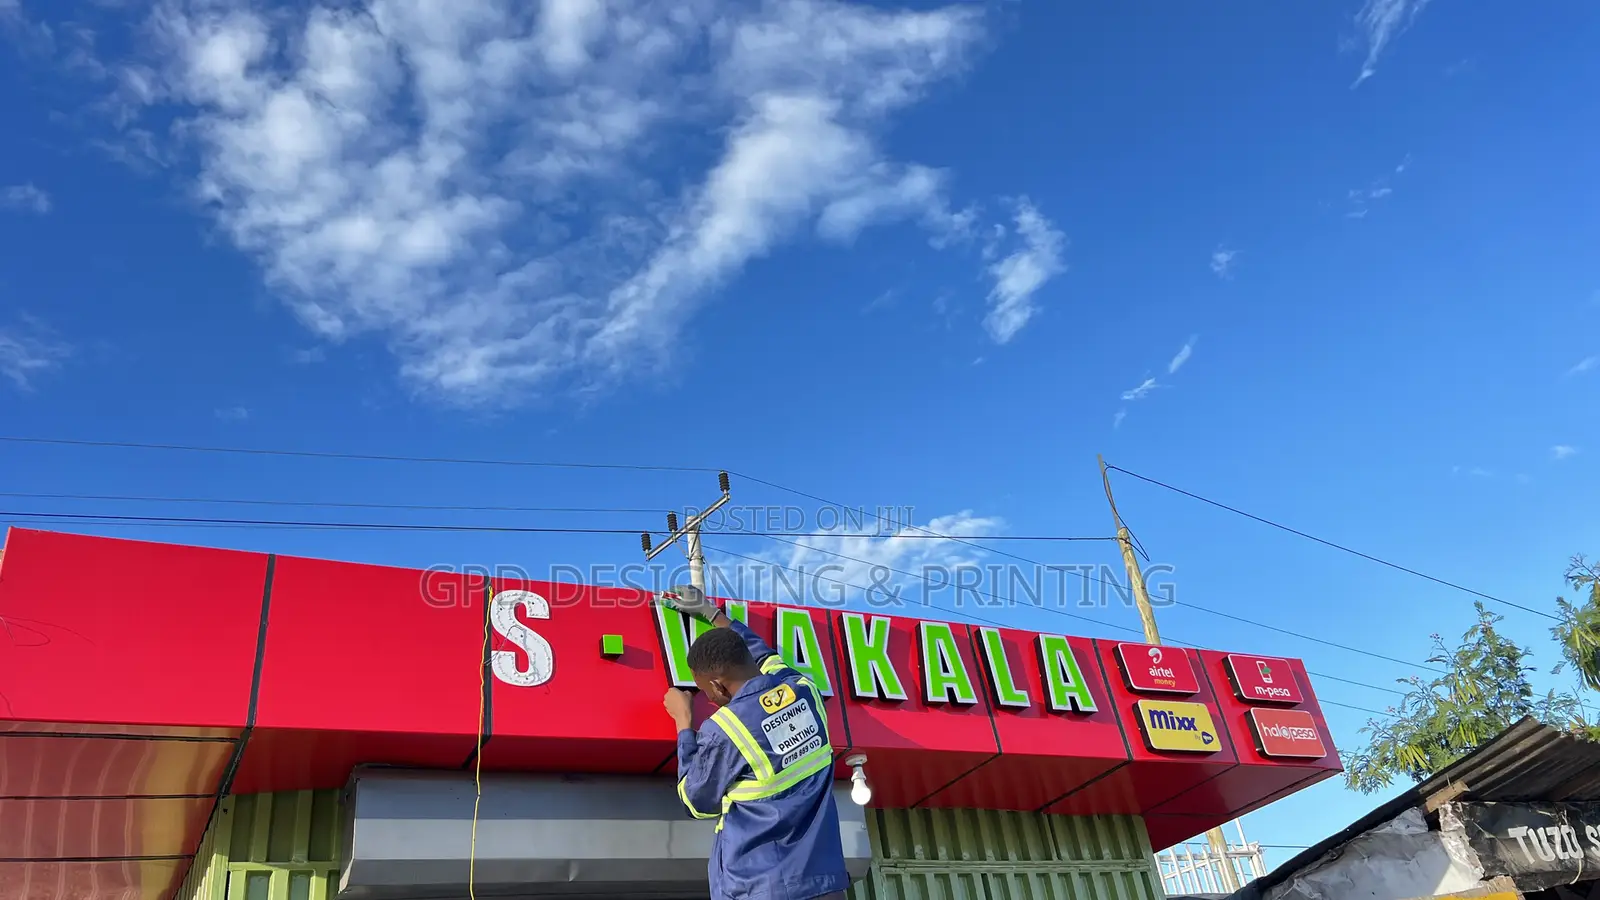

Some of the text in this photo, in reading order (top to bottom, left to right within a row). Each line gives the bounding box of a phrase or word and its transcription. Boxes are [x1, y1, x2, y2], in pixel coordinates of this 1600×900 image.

[490, 589, 553, 687] S
[1149, 665, 1175, 678] airtel
[1154, 679, 1176, 687] money
[1255, 687, 1291, 698] m-pesa
[763, 703, 806, 732] DESIGNING
[789, 723, 796, 732] &
[1261, 723, 1316, 741] halopesa
[778, 725, 815, 751] PRINTING
[1508, 825, 1584, 864] TUZO
